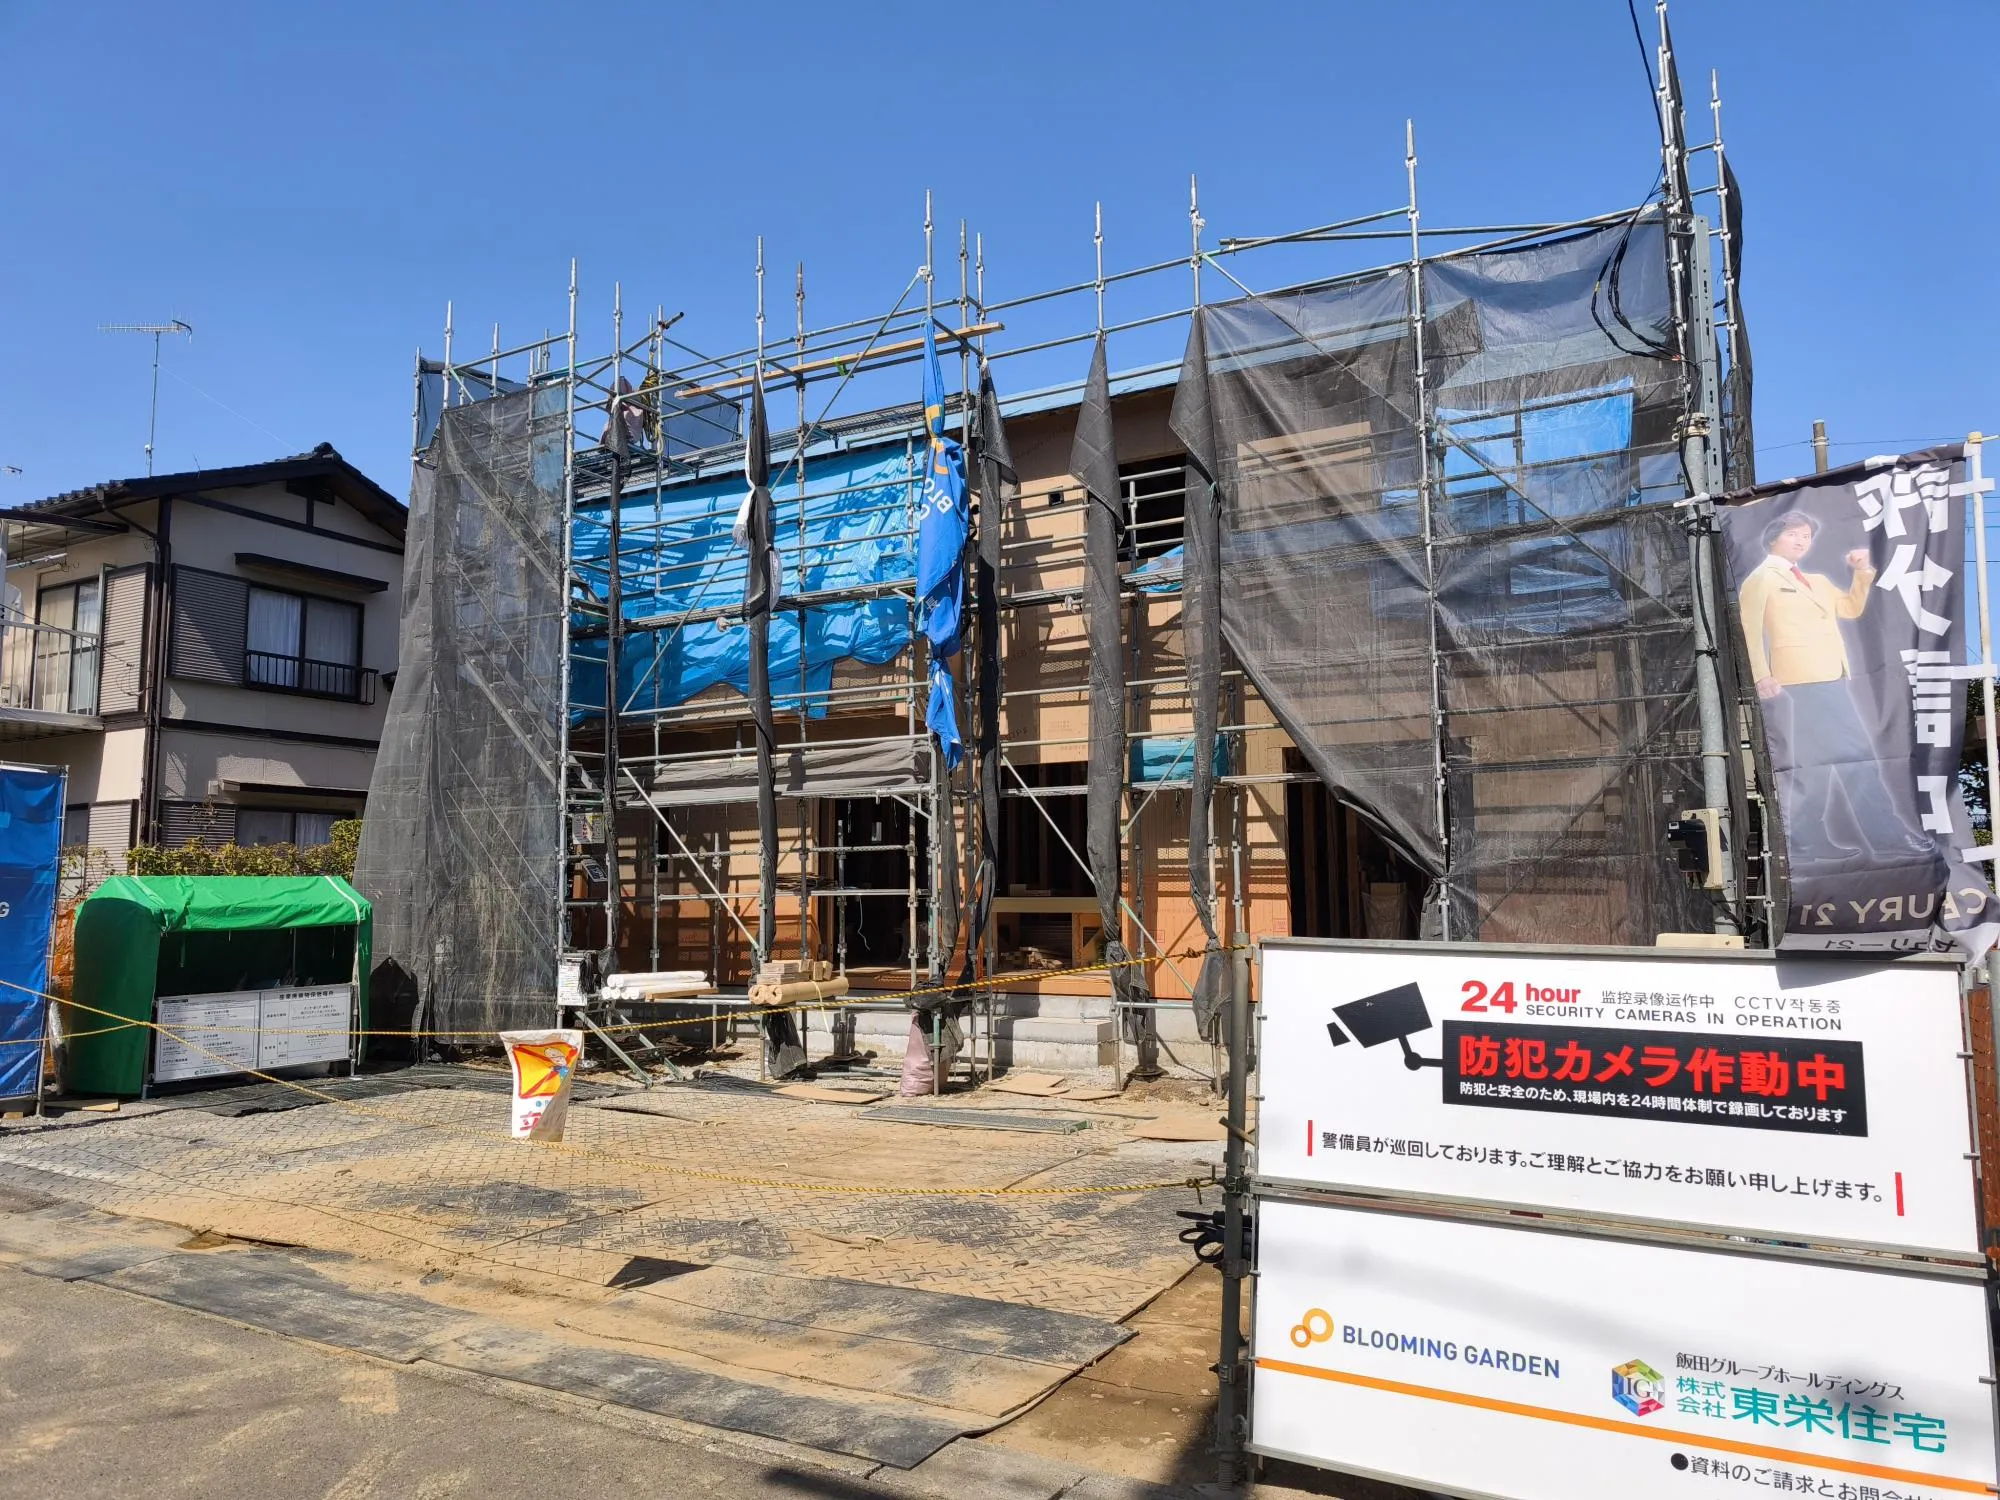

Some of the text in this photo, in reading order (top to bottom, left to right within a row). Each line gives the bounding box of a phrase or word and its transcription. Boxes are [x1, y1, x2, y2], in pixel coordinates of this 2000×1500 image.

[1461, 980, 1581, 1014] 24 hour
[1526, 1004, 1842, 1031] SECURITY CAMERAS IN OPERATION
[1601, 990, 1715, 1009] 监控录像运作中
[1459, 1035, 1846, 1101] 防犯カメラ作動中
[1343, 1325, 1560, 1379] BLOOMING GARDEN
[1675, 1351, 1905, 1401] 飯田グループホールディングス
[1730, 1387, 1948, 1453] 東栄住宅
